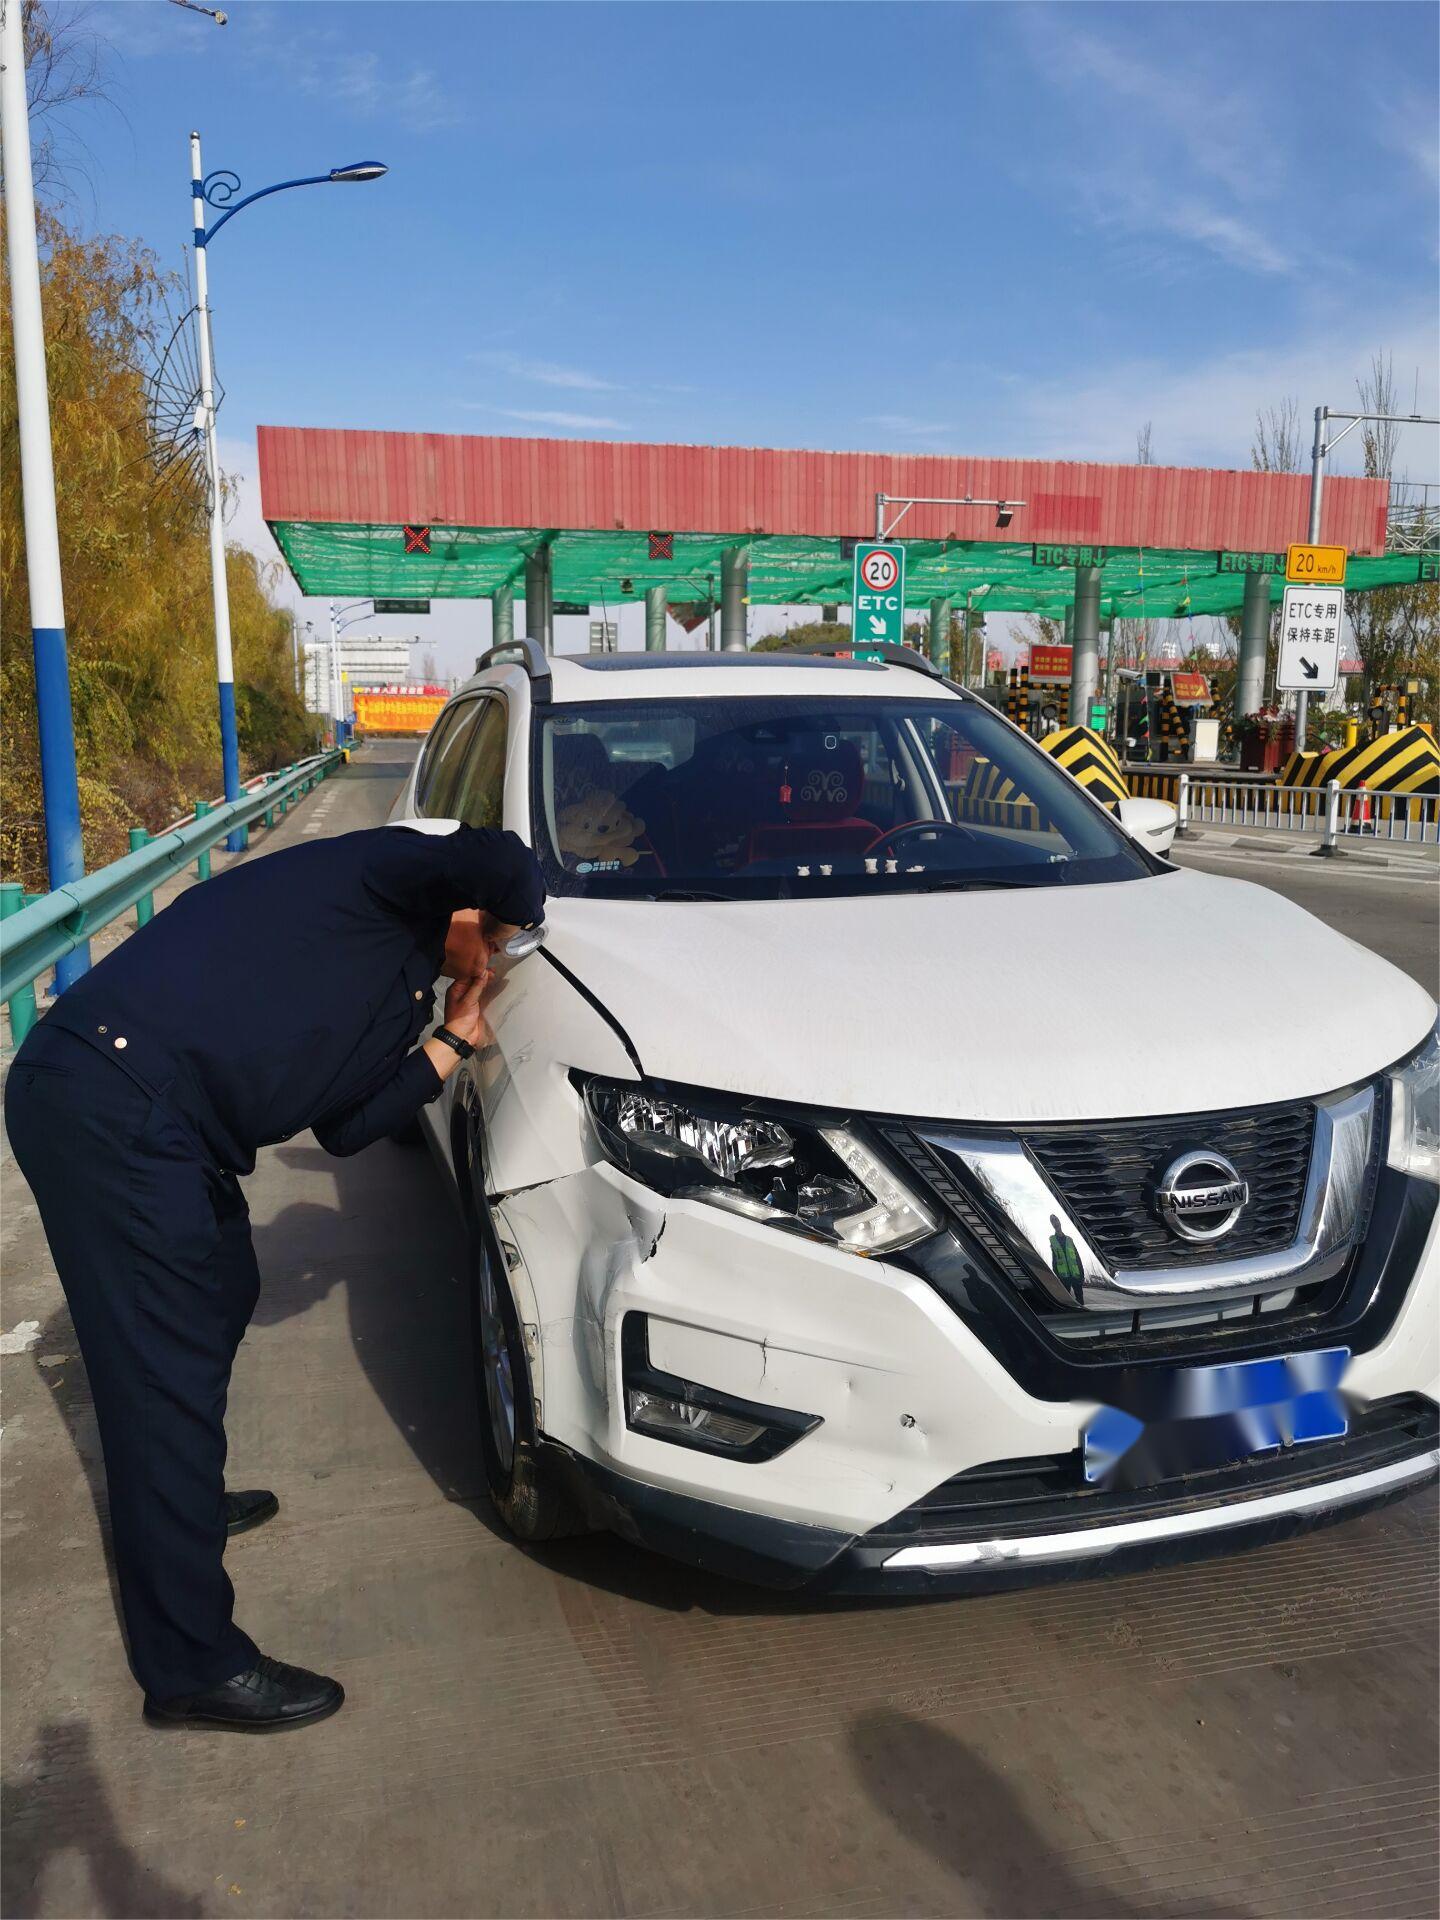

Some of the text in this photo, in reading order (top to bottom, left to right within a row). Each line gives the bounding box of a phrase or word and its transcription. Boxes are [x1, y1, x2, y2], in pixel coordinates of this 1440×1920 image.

[1035, 546, 1093, 568] ETC专用
[1296, 554, 1337, 574] 20 km/h
[870, 562, 891, 581] 20
[858, 595, 898, 611] ETC
[1289, 602, 1337, 620] ETC专用
[1287, 627, 1336, 644] 保持车距
[1169, 1189, 1244, 1213] NISSAN
